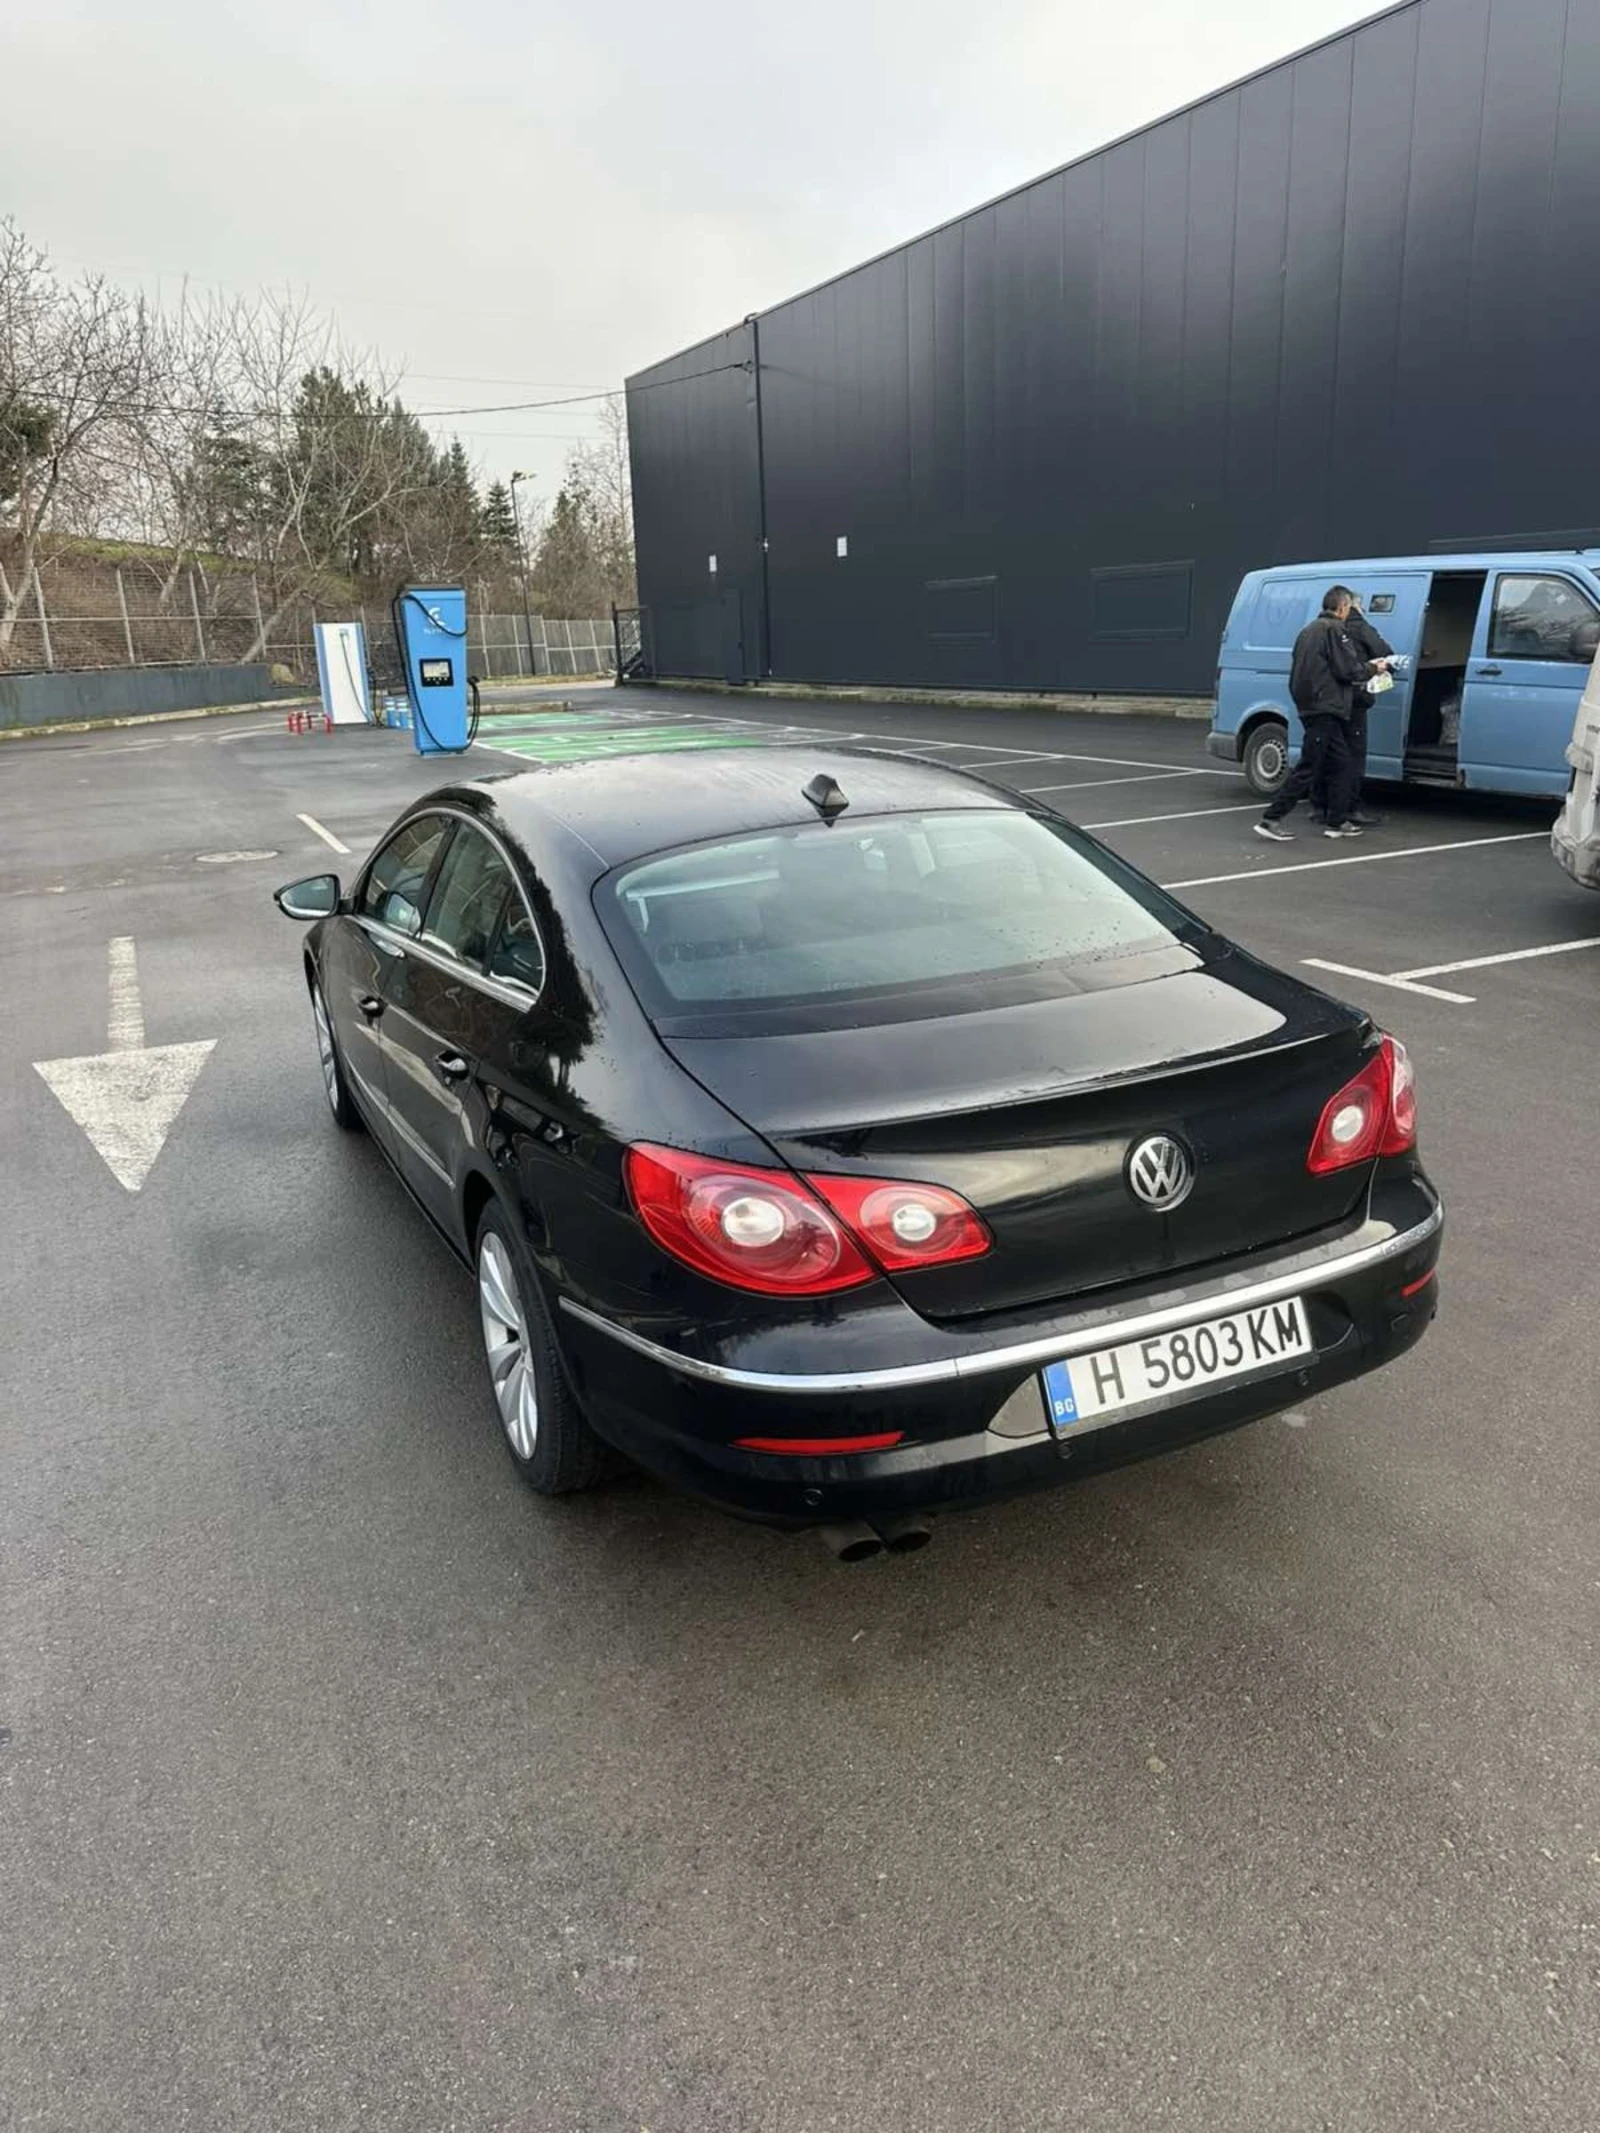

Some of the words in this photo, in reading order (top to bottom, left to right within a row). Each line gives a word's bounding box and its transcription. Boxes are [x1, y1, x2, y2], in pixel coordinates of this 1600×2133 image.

[1089, 1351, 1125, 1404] H
[1140, 1320, 1243, 1389] 5803
[1246, 1302, 1303, 1360] KM
[1055, 1398, 1074, 1416] BG
